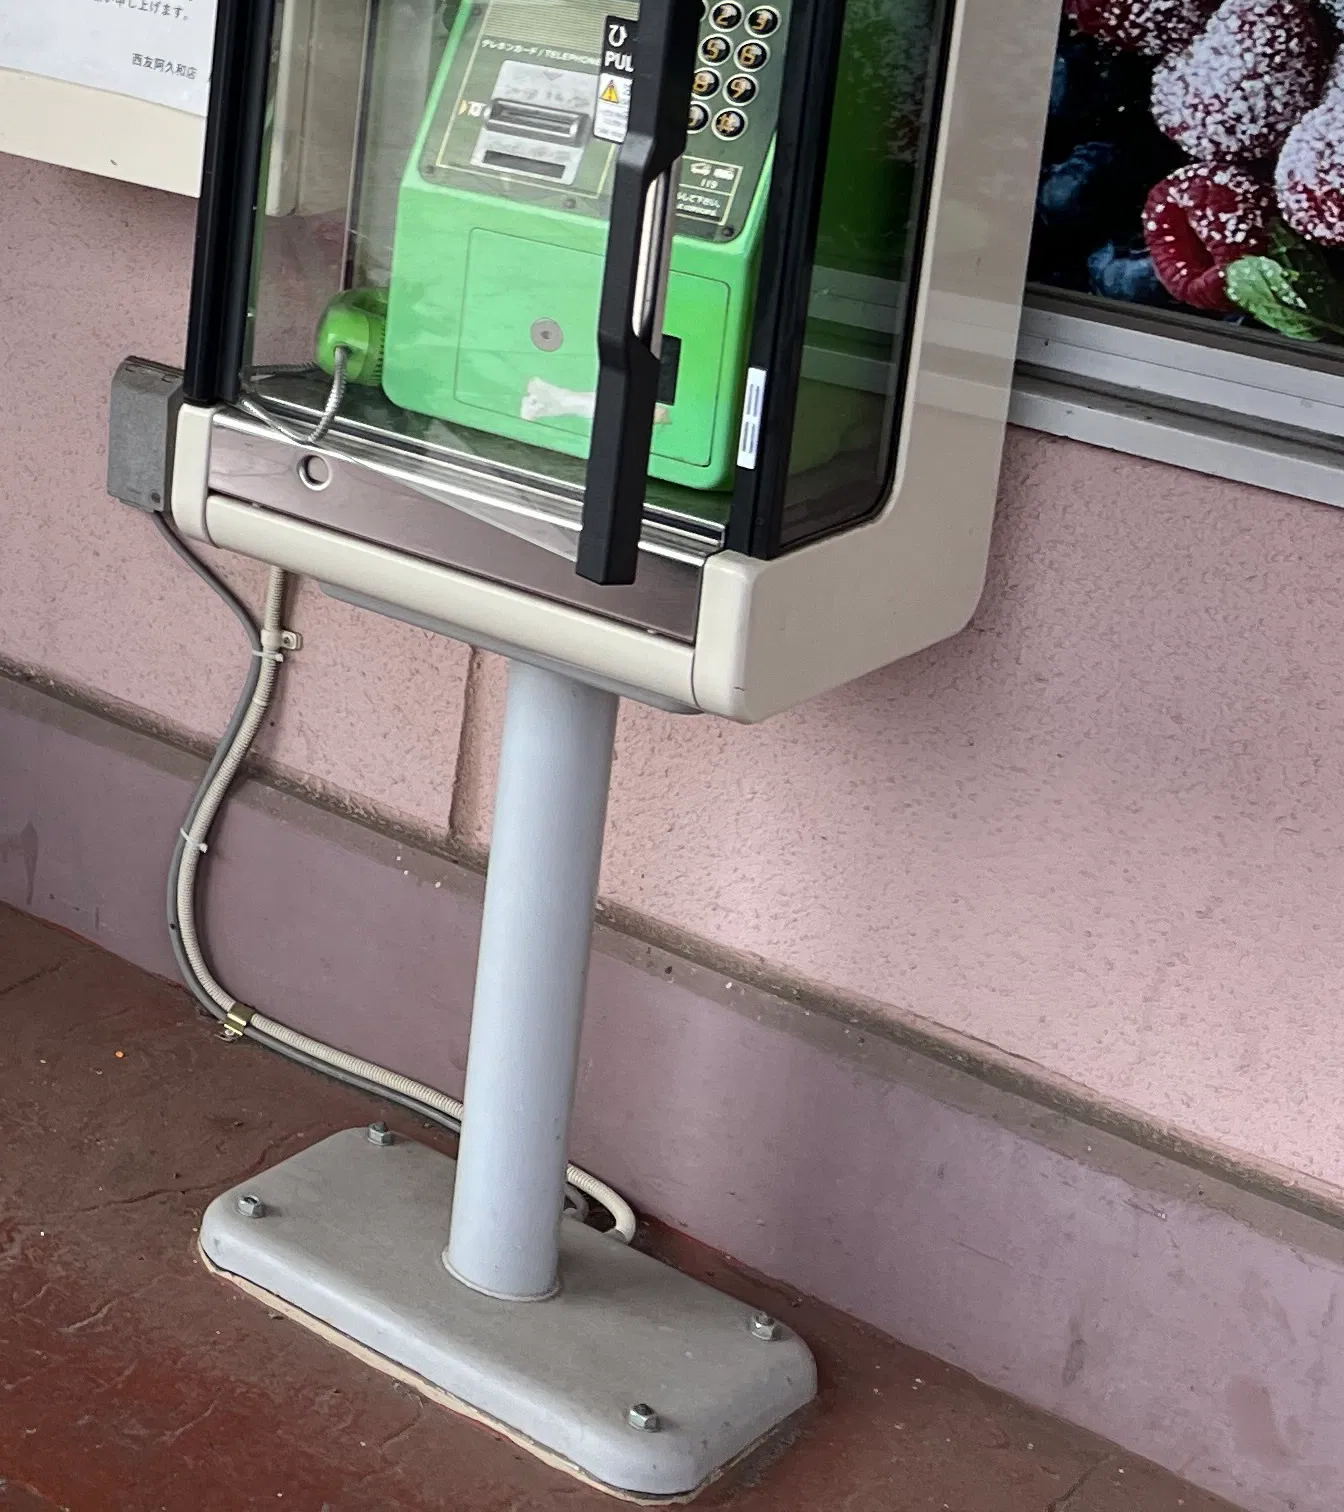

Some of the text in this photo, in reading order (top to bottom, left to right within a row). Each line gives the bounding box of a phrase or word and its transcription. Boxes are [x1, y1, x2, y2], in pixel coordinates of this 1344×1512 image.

[131, 52, 197, 80] 西友阿久和店
[604, 50, 635, 73] PUL
